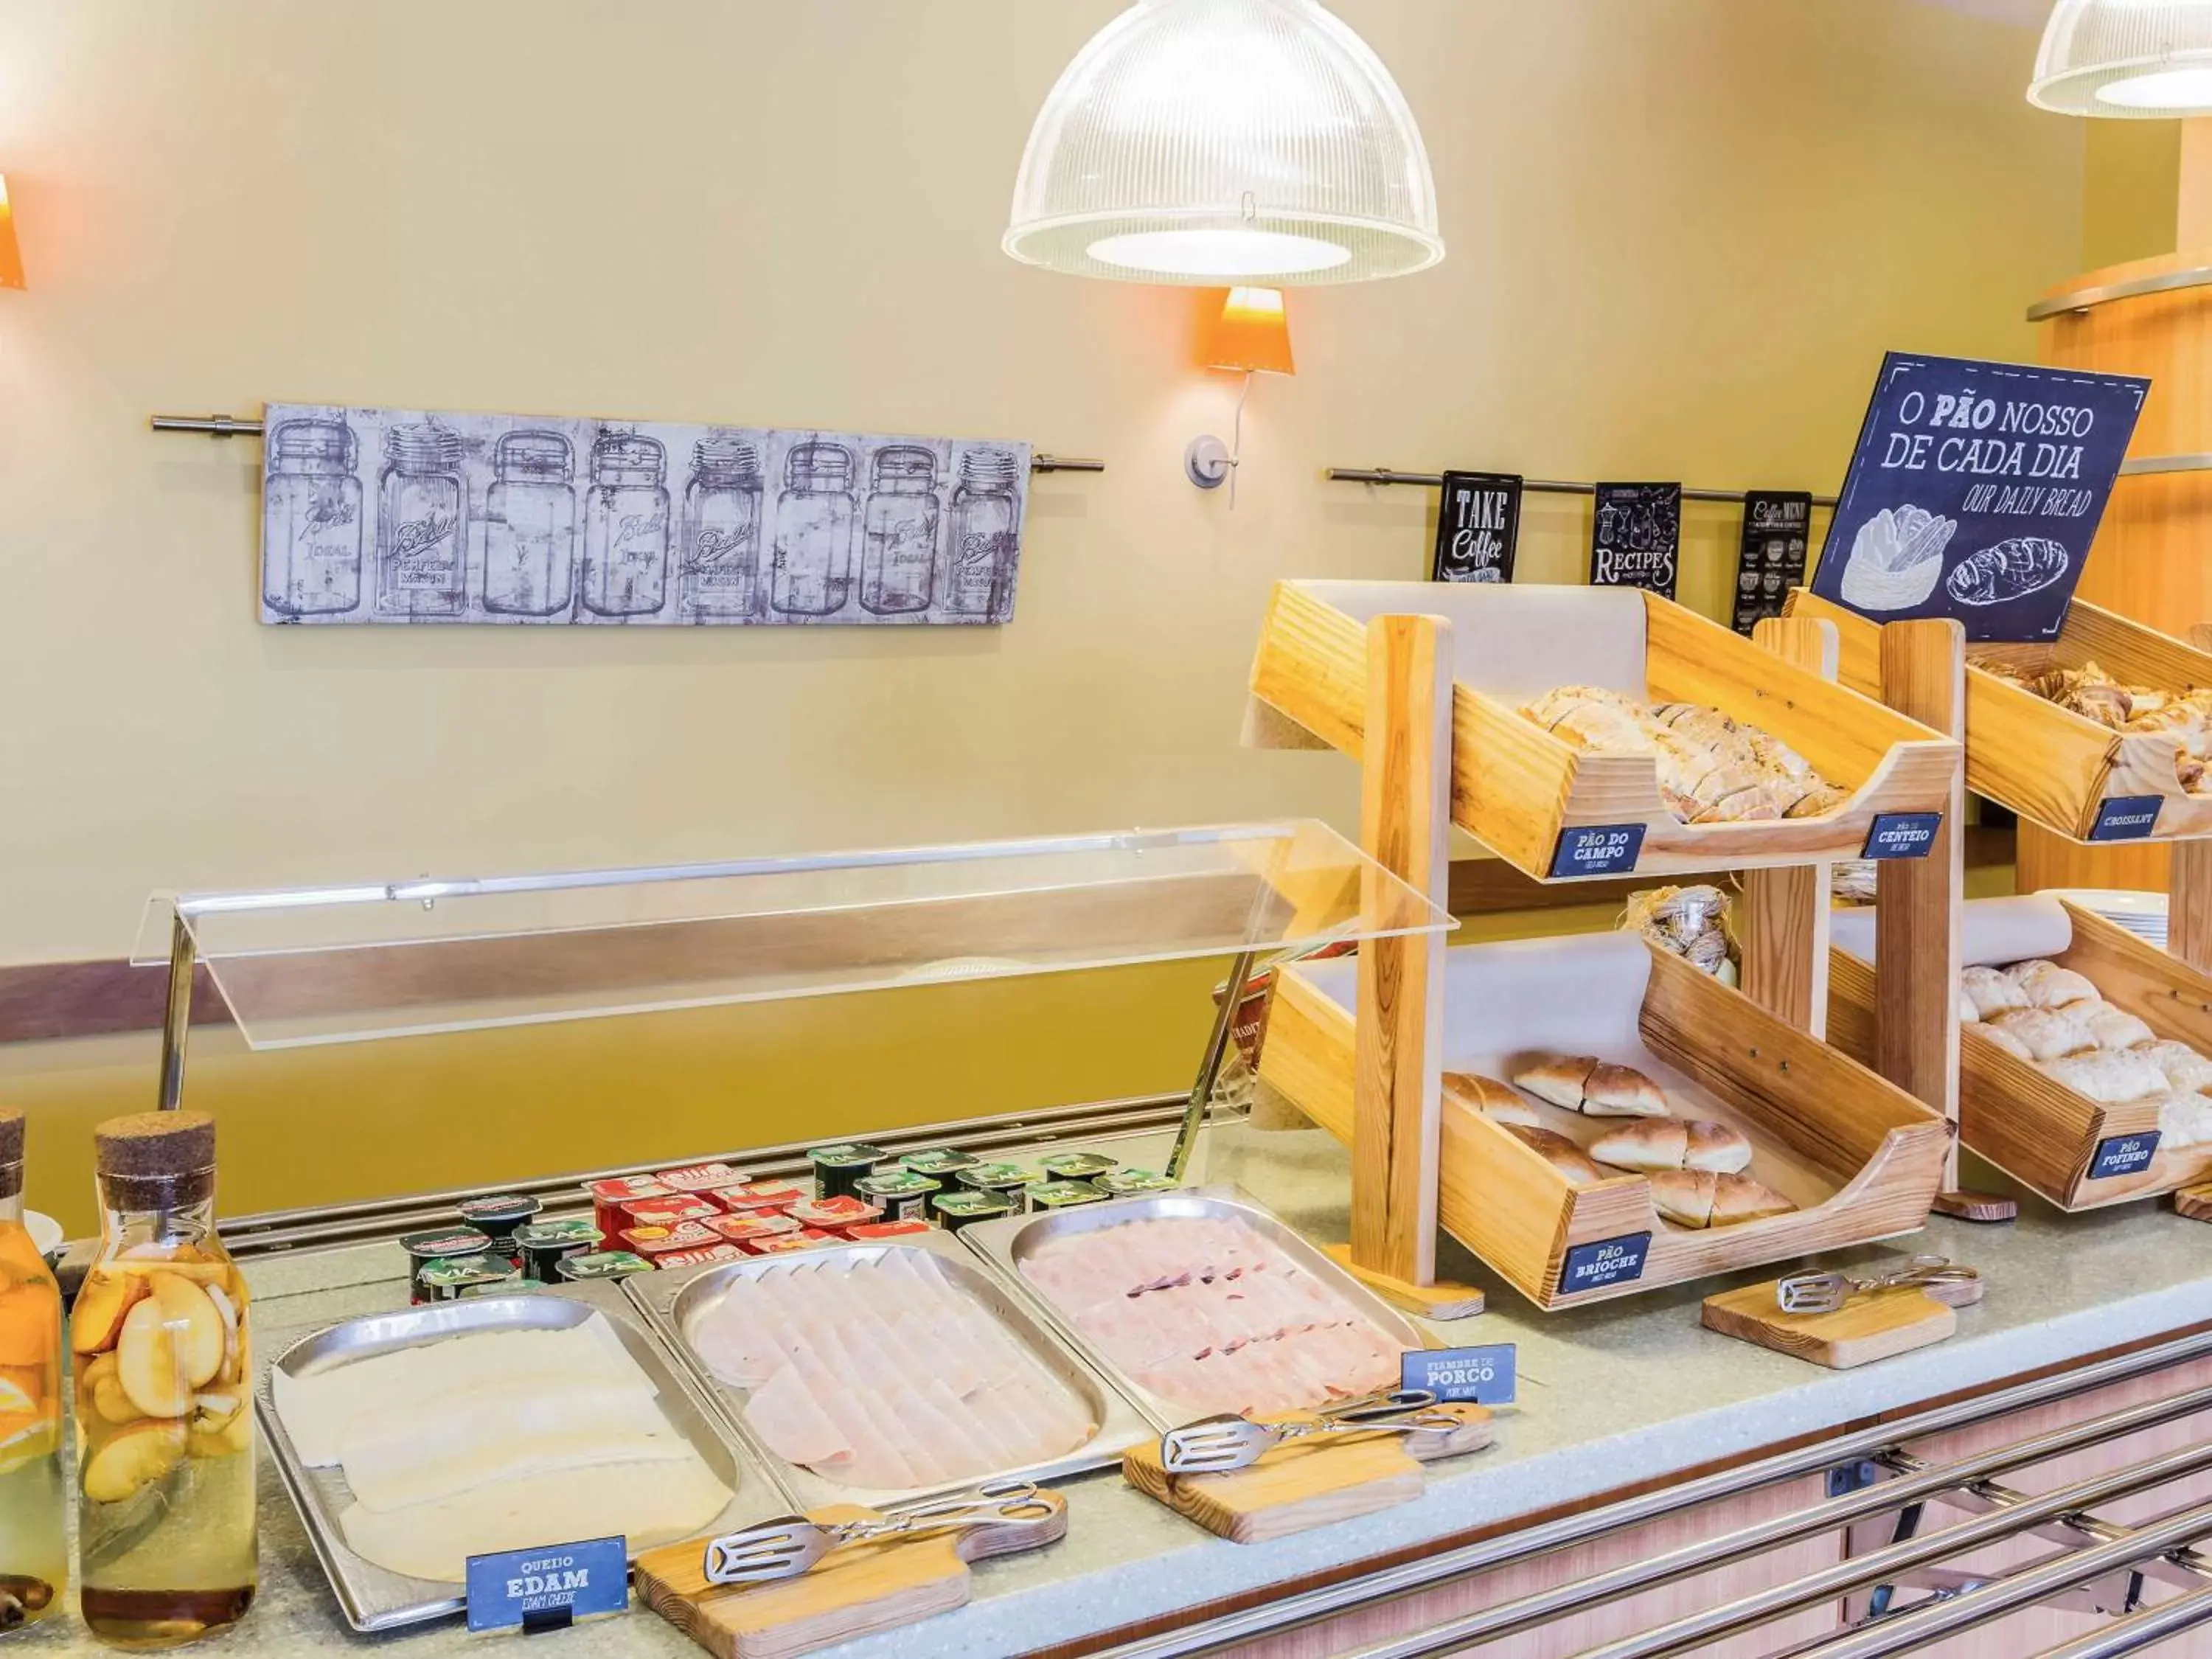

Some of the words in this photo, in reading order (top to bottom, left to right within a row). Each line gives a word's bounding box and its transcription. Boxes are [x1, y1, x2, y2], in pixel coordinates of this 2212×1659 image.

[1899, 391, 1925, 425] O
[1929, 388, 1996, 430] PÃO
[1998, 401, 2094, 438] NOSSO
[1881, 432, 1934, 470] DE
[1937, 437, 2026, 476] CADA
[2028, 442, 2084, 479] DIA
[1456, 489, 1509, 529] TAKE
[1962, 484, 1997, 513] OUR
[1994, 484, 2046, 515] DAILY
[2041, 487, 2093, 517] BREAD
[1451, 529, 1503, 567] Coffee
[1577, 831, 1606, 847] PÃO
[1607, 832, 1630, 846] DO
[1878, 830, 1930, 844] CENTEIO
[1573, 846, 1625, 861] CAMPO
[2120, 1139, 2141, 1153] PÃO
[1596, 1245, 1624, 1262] PÃO
[1574, 1254, 1639, 1279] BRIOCHE
[1427, 1358, 1478, 1371] FIAMBRE
[1427, 1366, 1495, 1387] PORCO
[507, 1568, 589, 1599] EDAM
